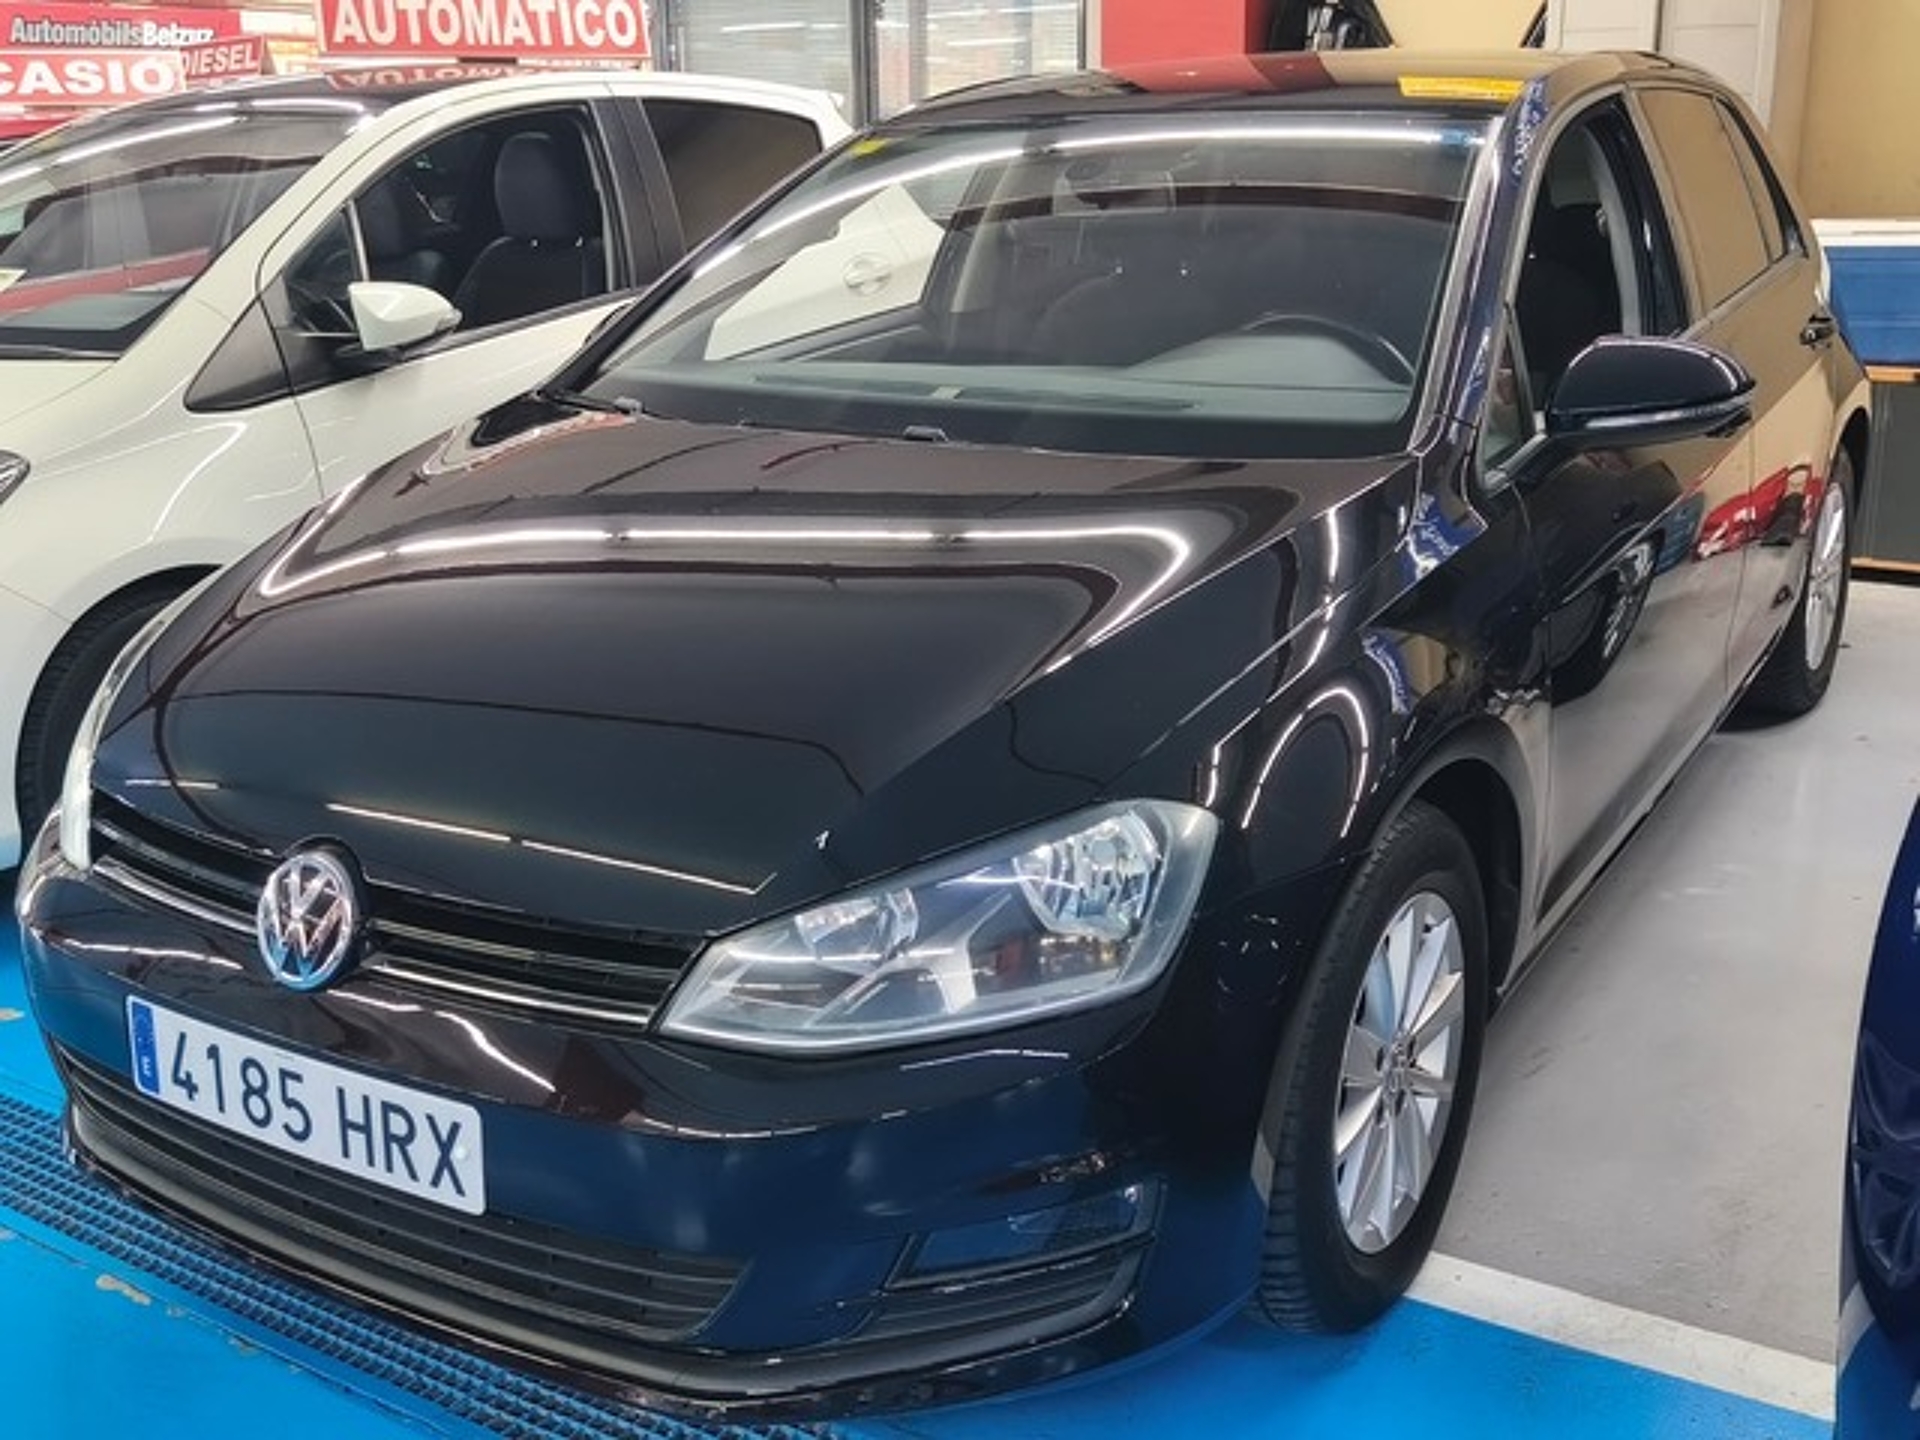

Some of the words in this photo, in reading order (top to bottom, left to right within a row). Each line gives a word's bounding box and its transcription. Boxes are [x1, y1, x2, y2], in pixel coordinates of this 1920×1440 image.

[333, 0, 638, 47] AUTOMATICO
[171, 1031, 313, 1142] 4185
[337, 1086, 466, 1197] HRX
